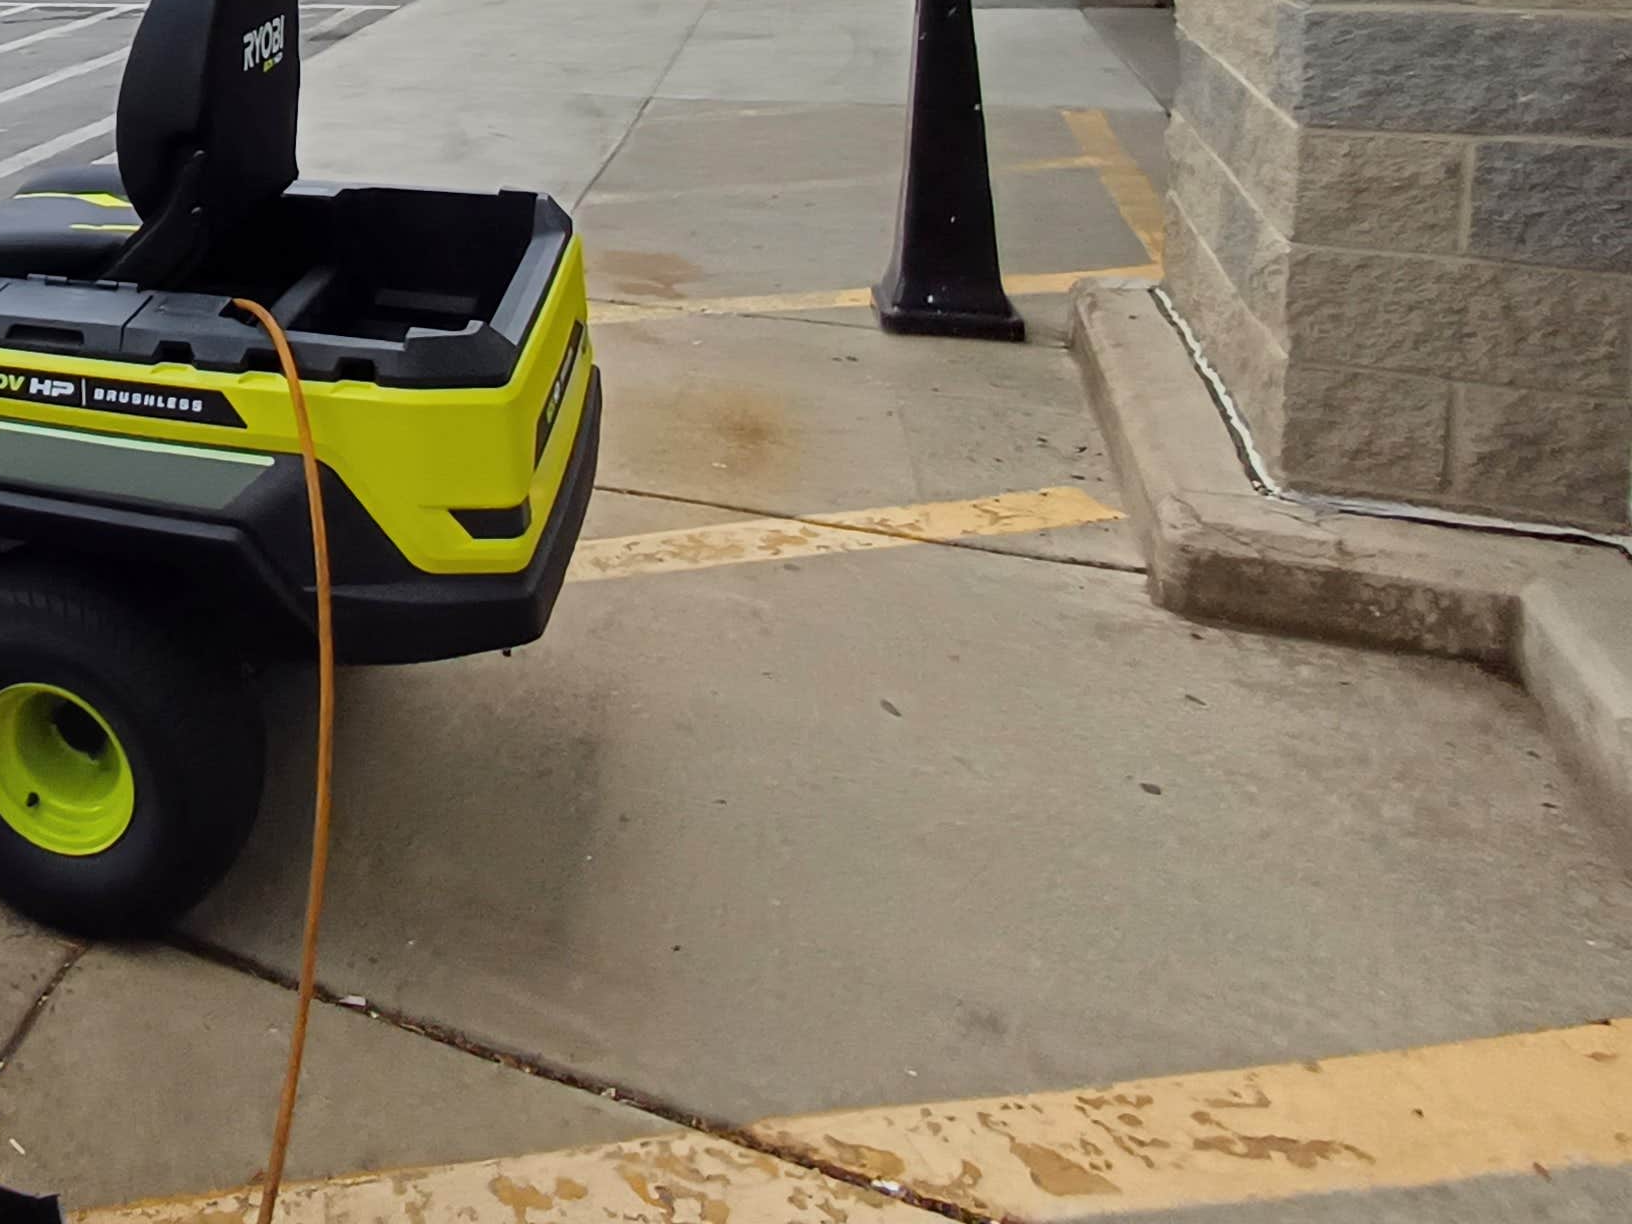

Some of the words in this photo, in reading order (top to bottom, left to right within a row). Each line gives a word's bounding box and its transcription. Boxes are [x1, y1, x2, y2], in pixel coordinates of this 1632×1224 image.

[243, 15, 285, 71] RYOBI
[28, 377, 75, 397] HP
[93, 387, 204, 413] BRUSHLESS
